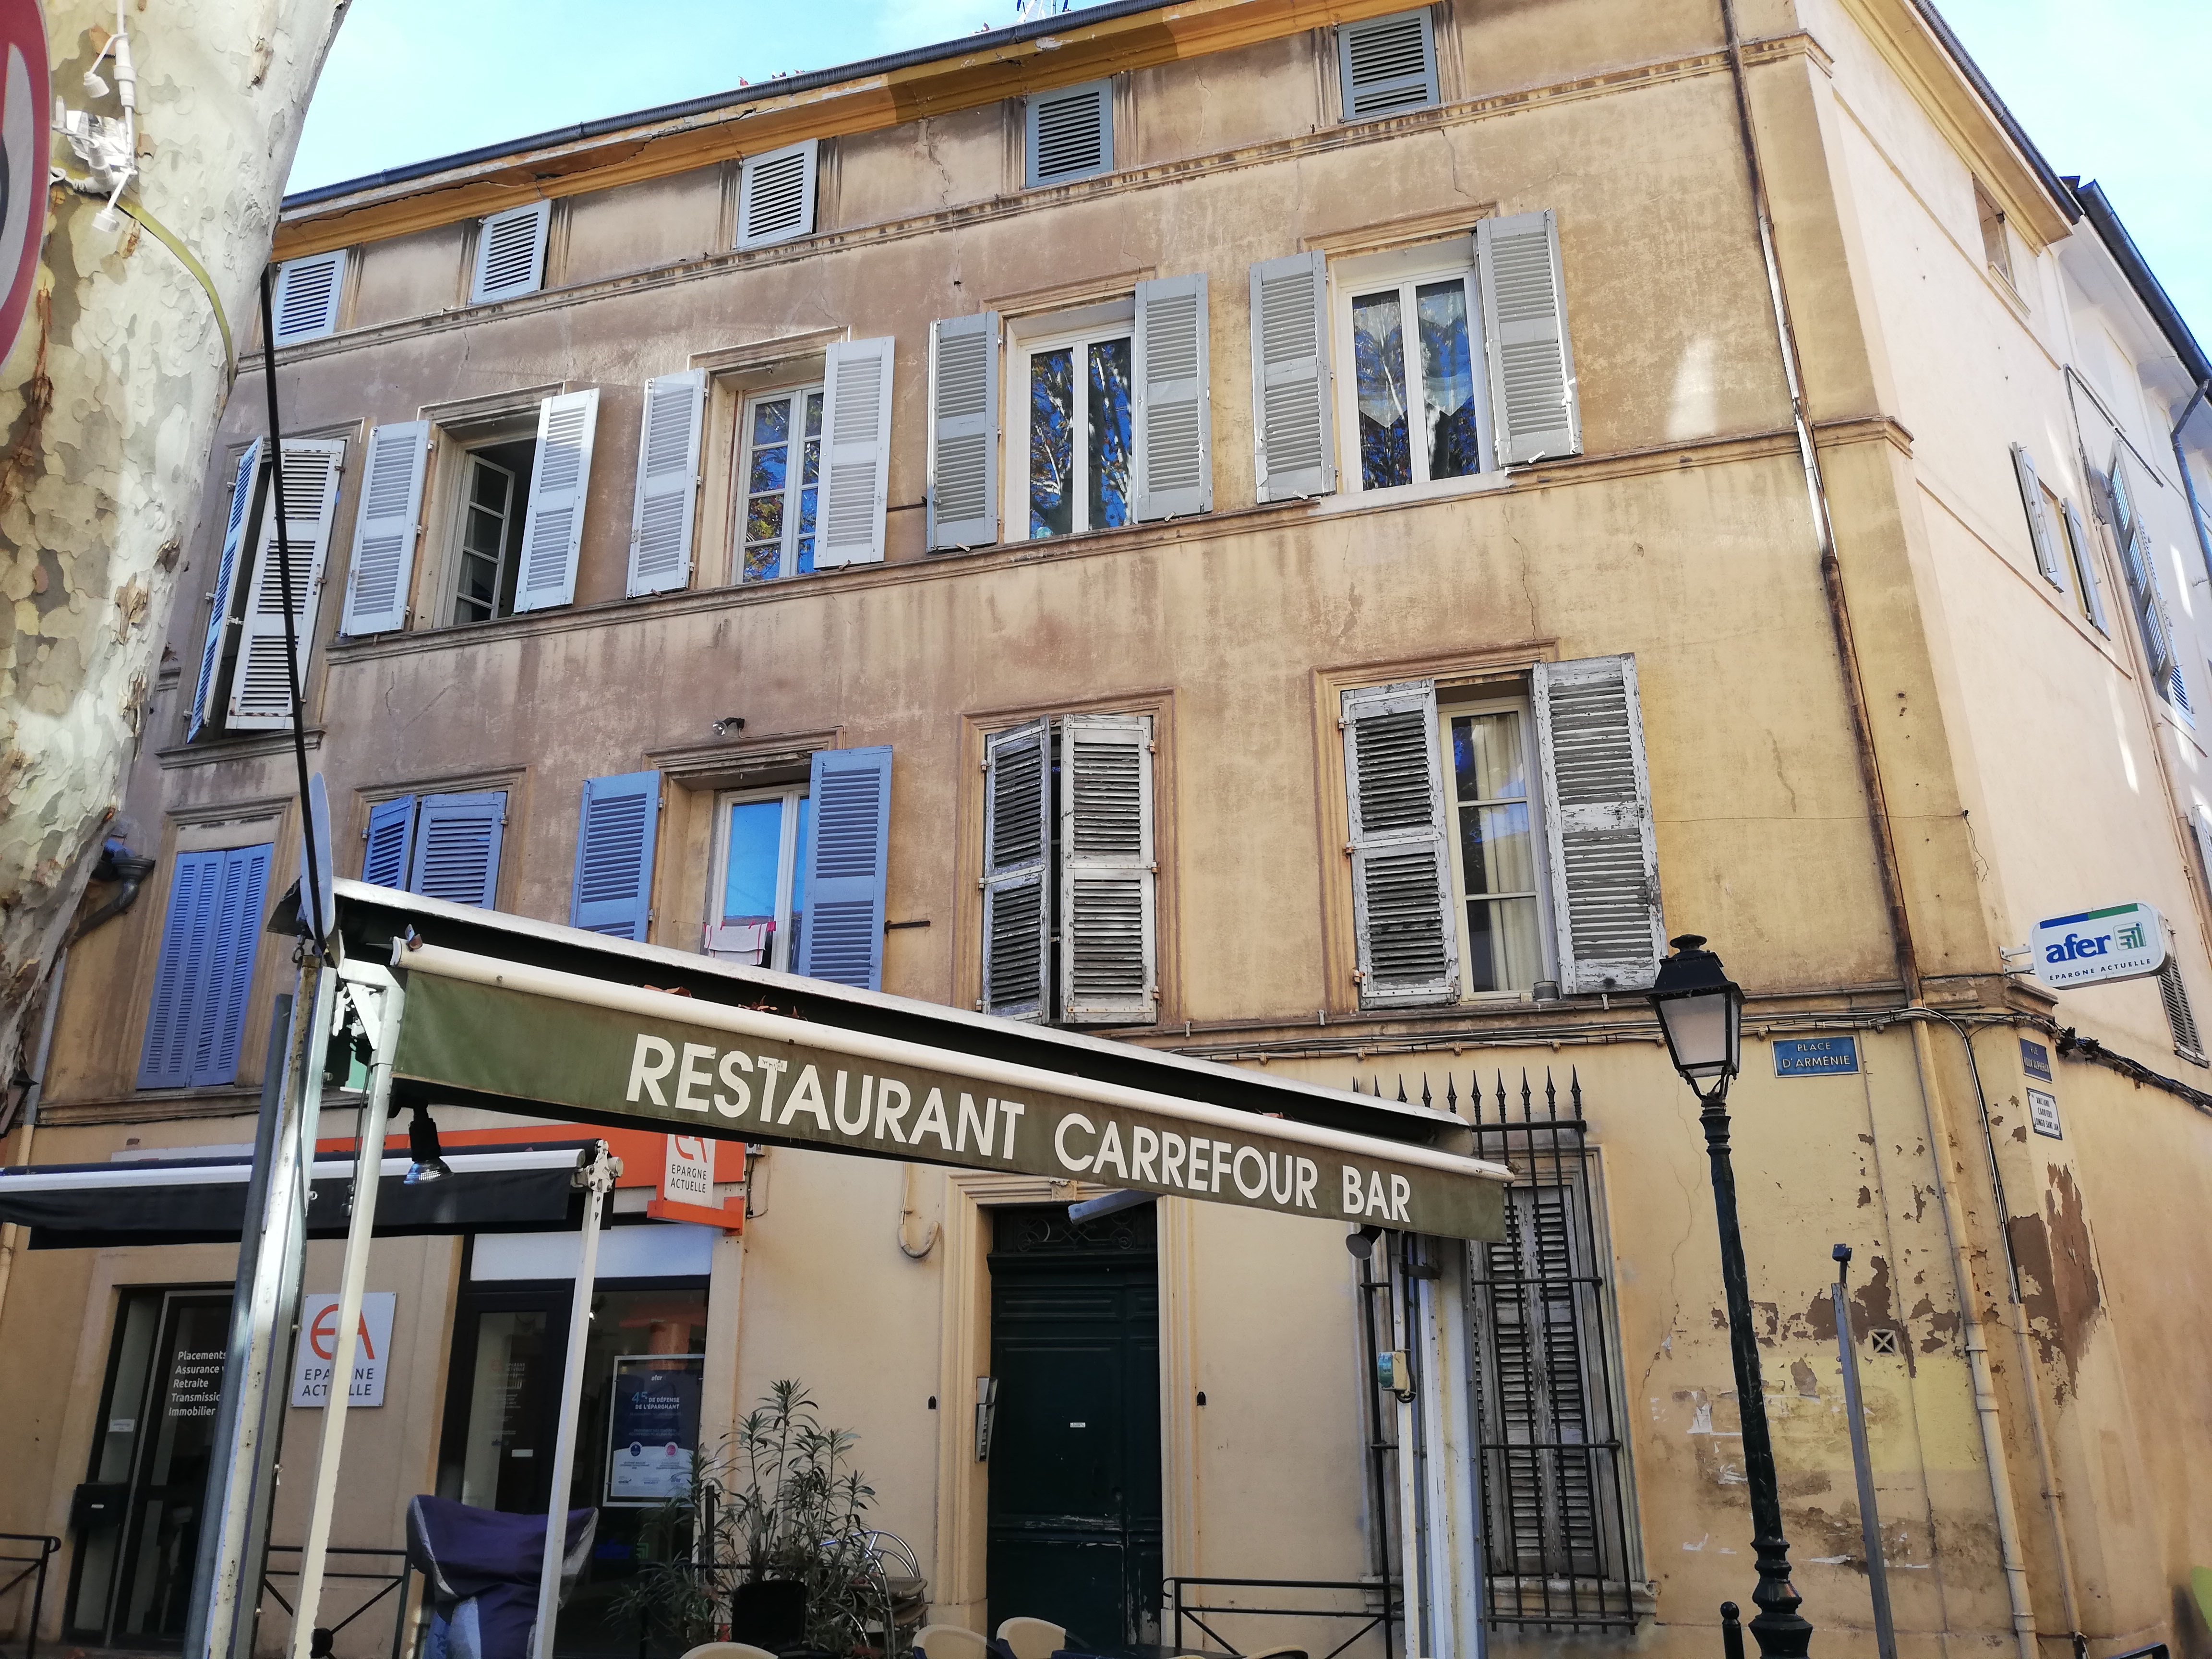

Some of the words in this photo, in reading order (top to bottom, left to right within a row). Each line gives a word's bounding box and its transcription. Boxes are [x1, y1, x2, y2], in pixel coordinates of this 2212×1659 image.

[2045, 933, 2111, 963] afer
[2049, 968, 2095, 981] EPARGNE
[2100, 958, 2151, 972] ACTUELLE
[1797, 1042, 1831, 1052] PLACE
[1782, 1055, 1851, 1068] D'ARMÉNIE
[626, 1033, 1025, 1160] RESTAURANT
[1055, 1113, 1319, 1209] CARREFOUR
[1342, 1165, 1411, 1223] BAR
[672, 1164, 707, 1180] EPARGNE
[671, 1178, 706, 1193] ACTUELLE
[175, 1365, 219, 1374] Assurance
[304, 1368, 374, 1381] EPANE
[173, 1378, 209, 1388] Retraite
[302, 1384, 372, 1396] ACTLLE
[168, 1406, 216, 1417] Immobilier
